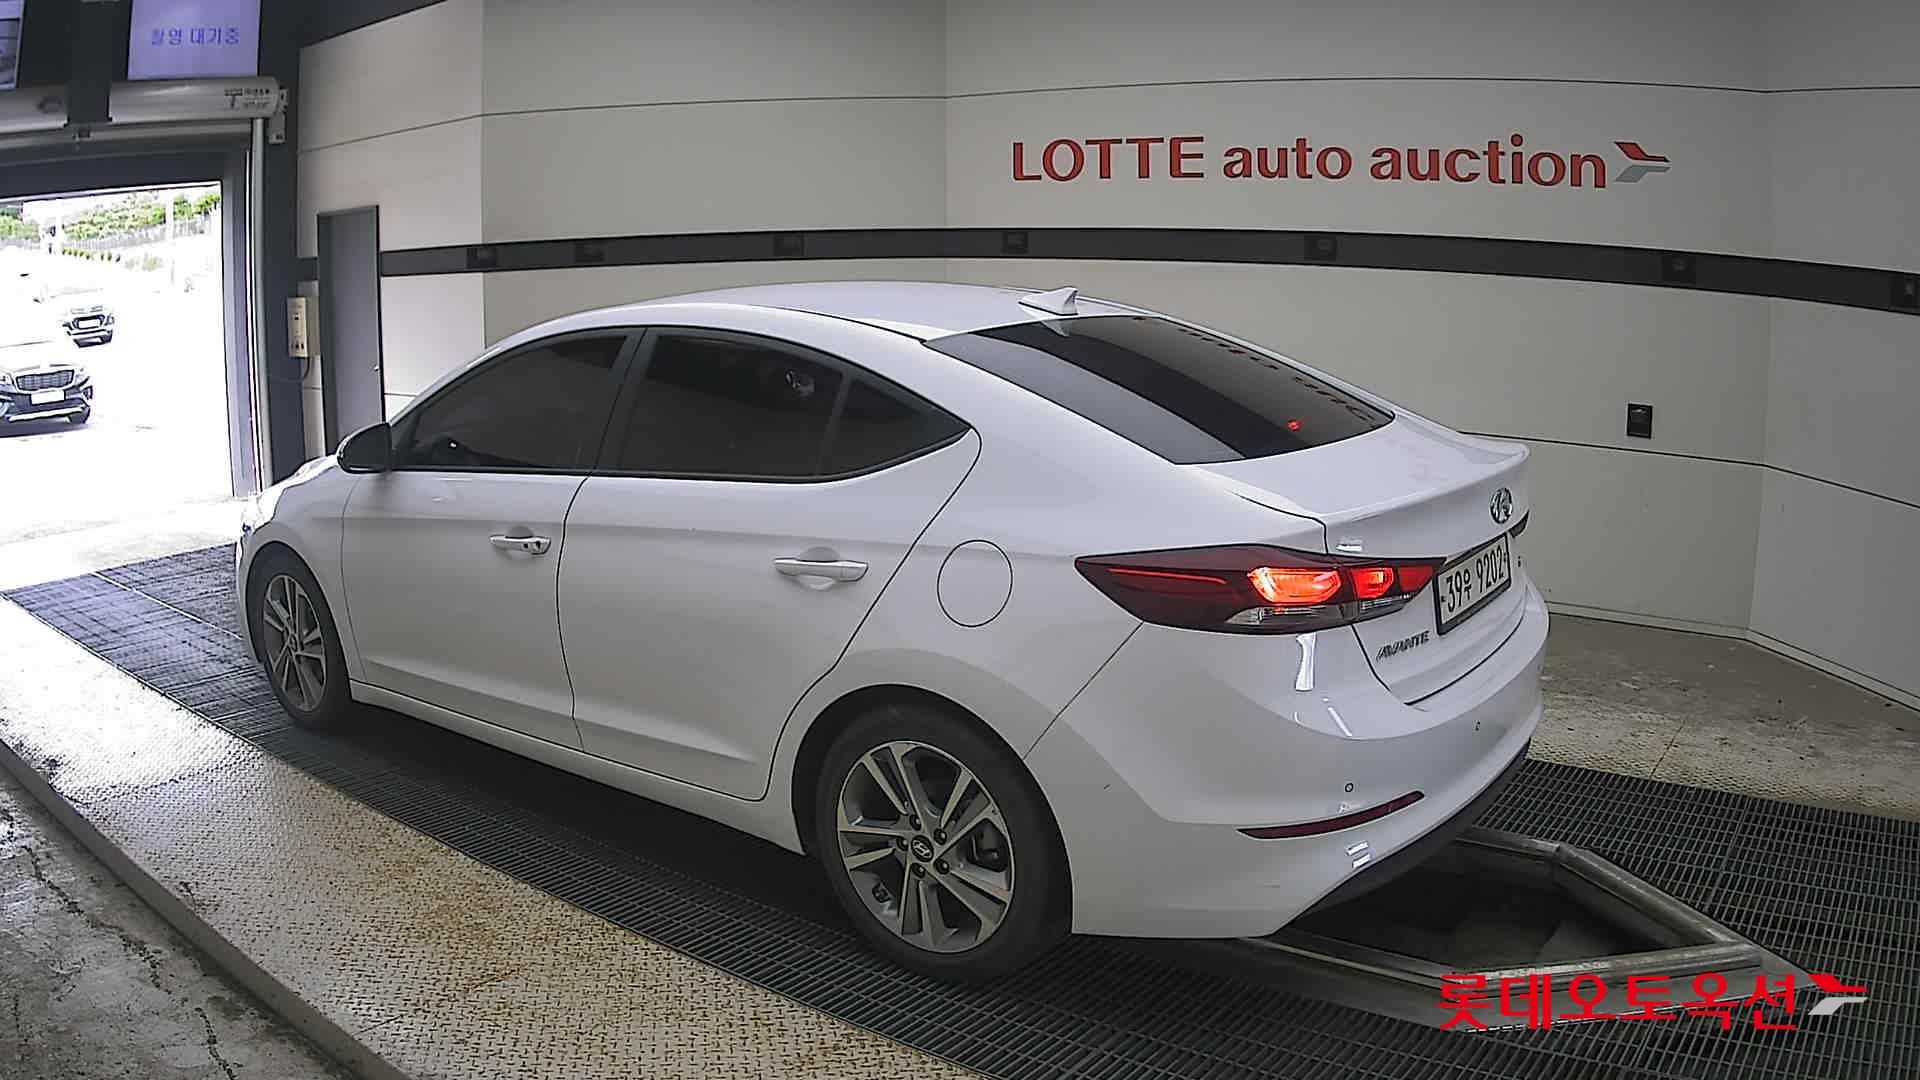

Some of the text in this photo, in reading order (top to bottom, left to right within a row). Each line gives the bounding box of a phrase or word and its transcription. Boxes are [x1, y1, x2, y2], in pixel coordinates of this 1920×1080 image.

[189, 27, 239, 46] 대기중
[1012, 133, 1607, 189] LOTTE auto auction
[1446, 546, 1504, 613] 39우 9202
[1376, 630, 1429, 662] AVANTE
